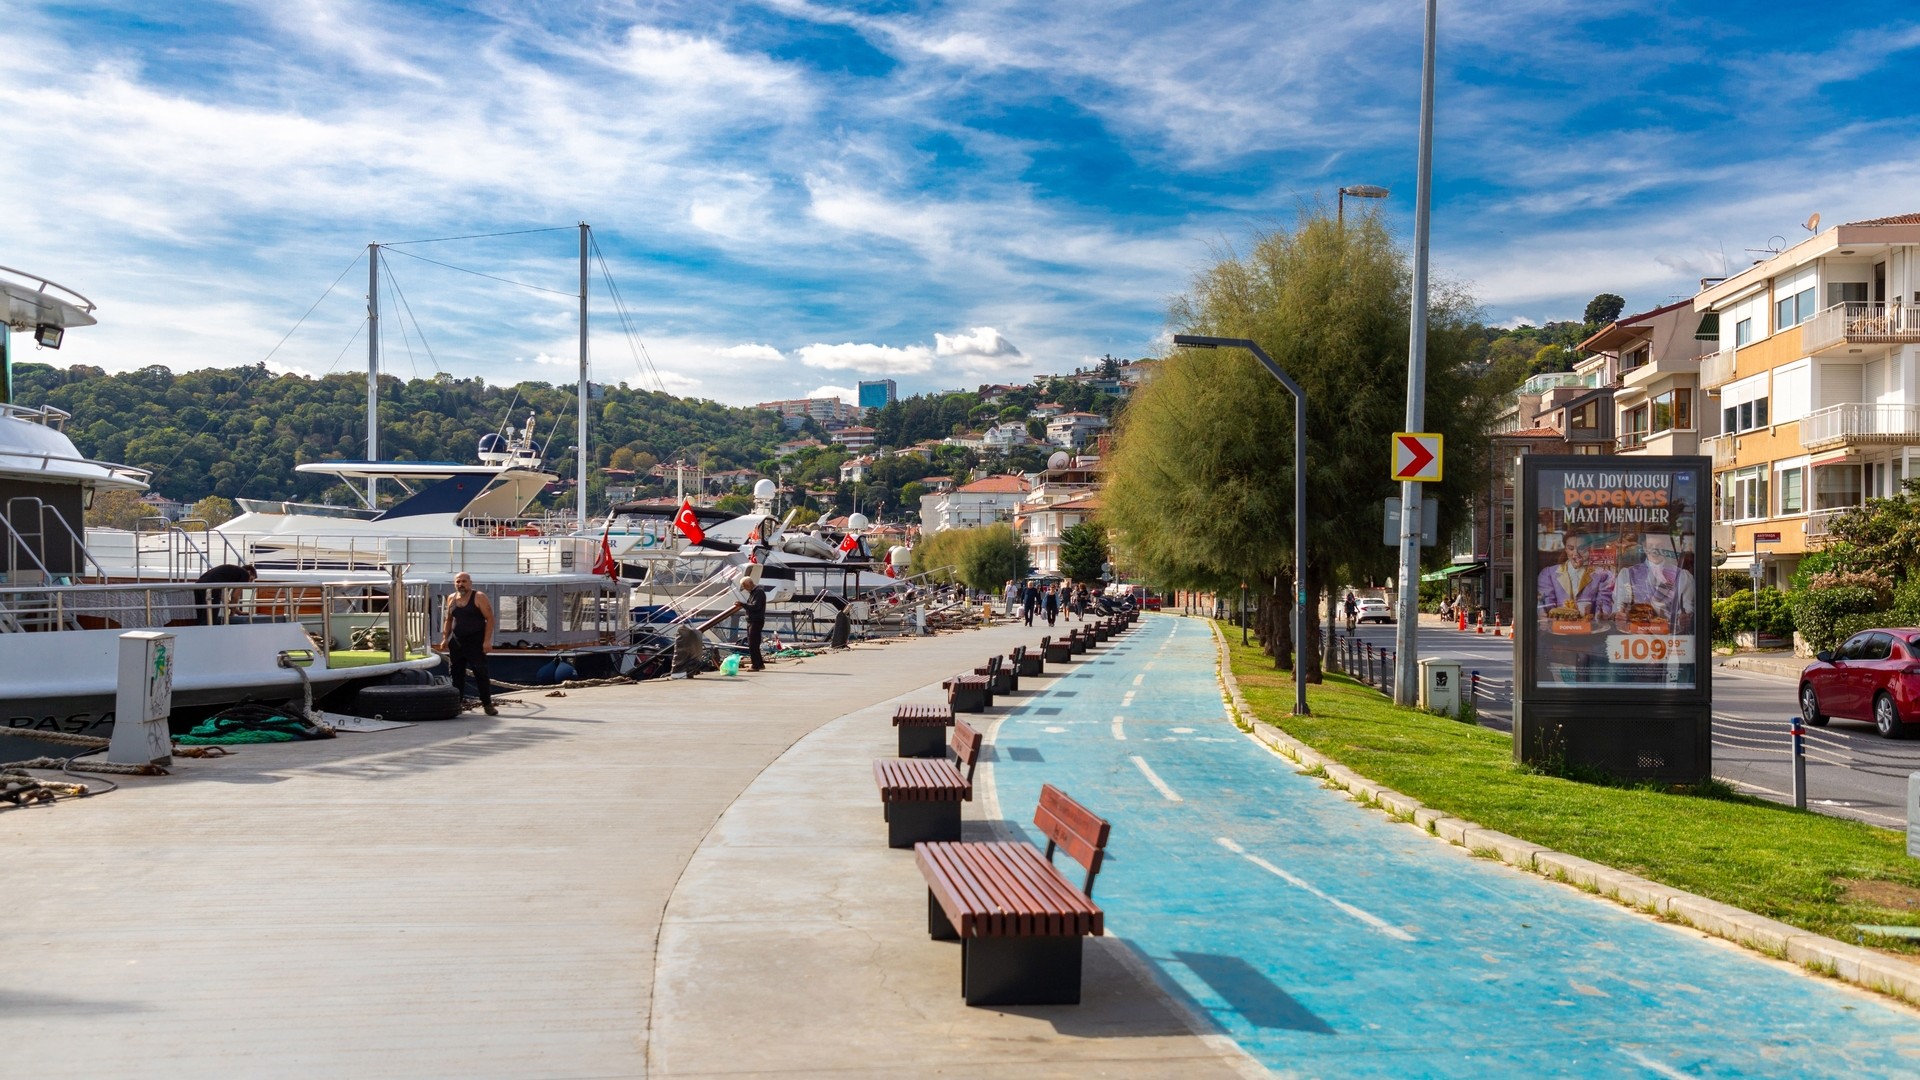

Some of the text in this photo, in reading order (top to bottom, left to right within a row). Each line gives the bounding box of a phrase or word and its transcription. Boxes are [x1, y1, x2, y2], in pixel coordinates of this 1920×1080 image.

[1564, 473, 1669, 489] MAX DOYURUCU
[1564, 489, 1668, 507] POPEYES
[1604, 506, 1669, 523] MENÜLER
